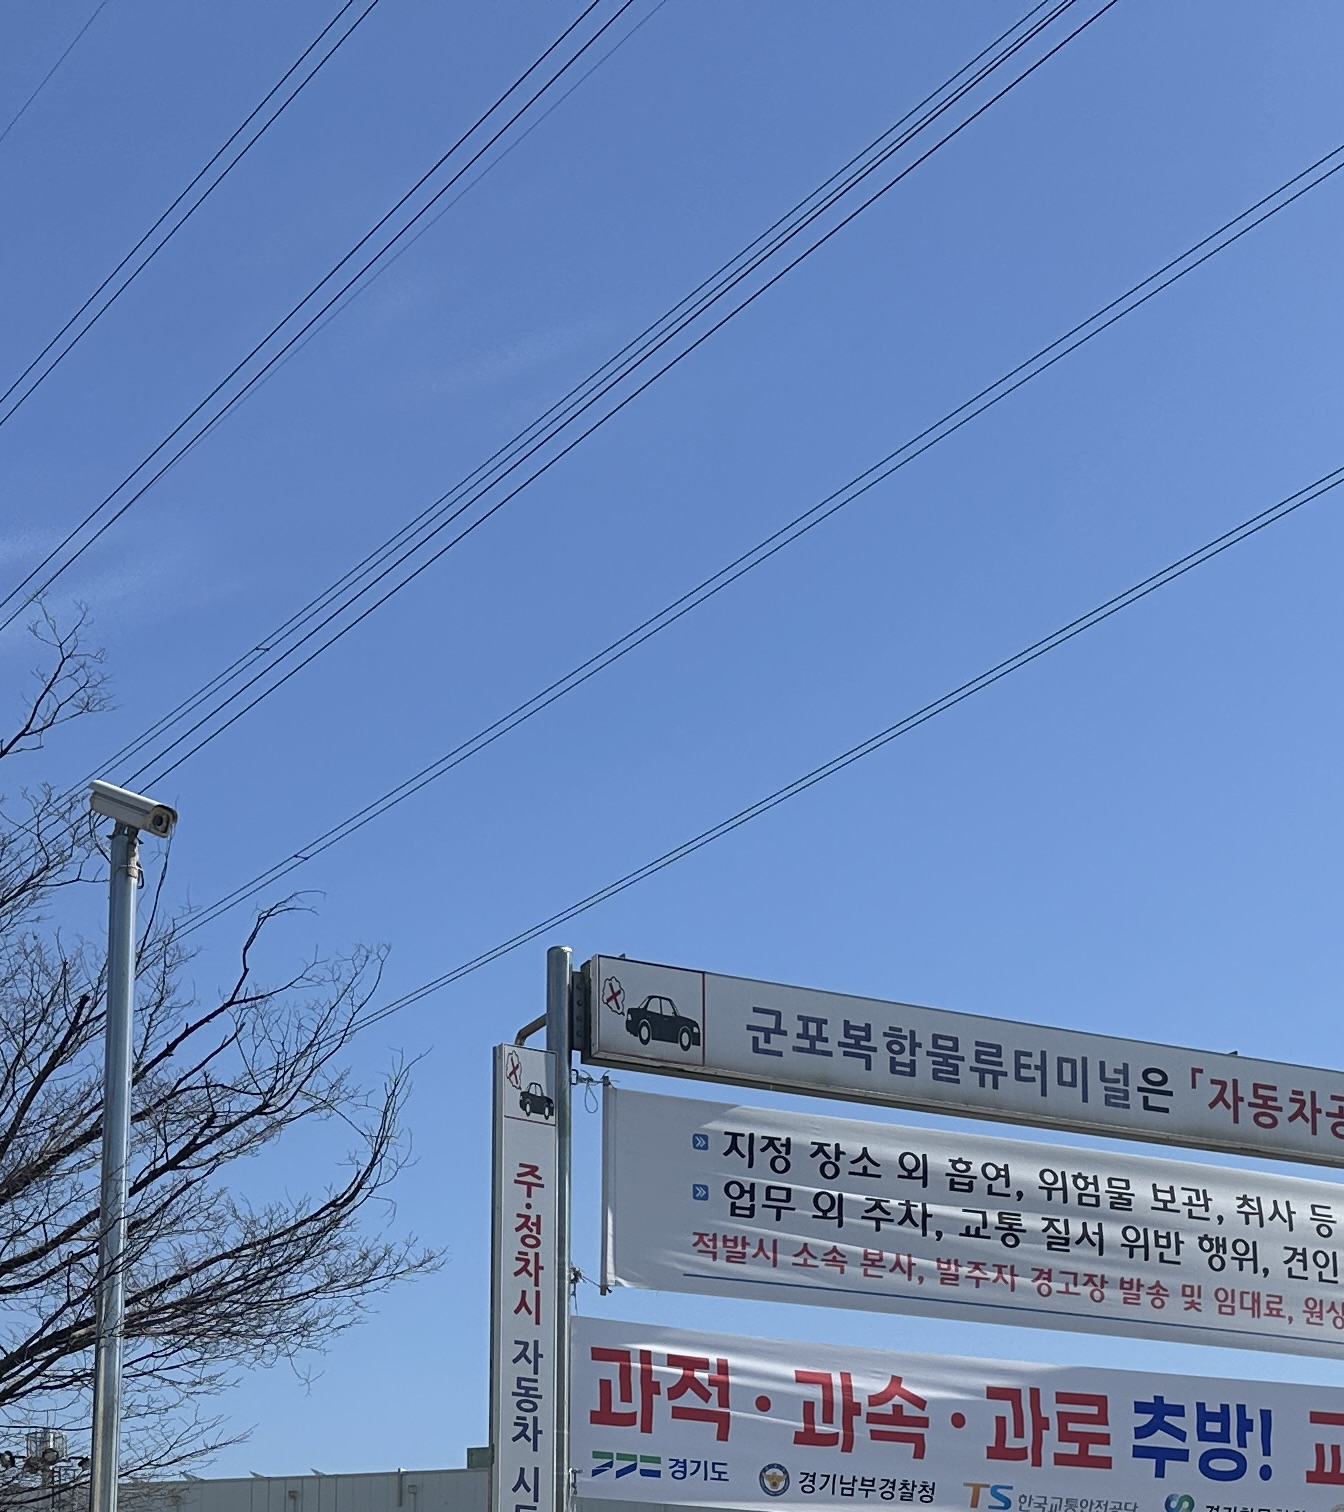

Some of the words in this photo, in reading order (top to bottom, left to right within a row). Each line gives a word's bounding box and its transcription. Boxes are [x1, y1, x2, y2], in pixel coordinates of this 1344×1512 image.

[723, 1131, 792, 1174] 지정
[808, 1141, 882, 1181] 장소
[896, 1151, 927, 1188] 외
[944, 1157, 1023, 1201] 흡연,
[1037, 1167, 1135, 1212] 위험물
[1150, 1182, 1224, 1225] 보관,
[1235, 1194, 1296, 1232] 취사
[1309, 1203, 1337, 1239] 등
[723, 1179, 795, 1223] 업무
[810, 1191, 844, 1229] 외
[860, 1198, 944, 1242] 주차,
[957, 1207, 1028, 1249] 교통
[1040, 1214, 1105, 1255] 질서
[1120, 1224, 1185, 1266] 위반
[1197, 1233, 1270, 1278] 행위,
[1282, 1244, 1339, 1284] 견인
[690, 1231, 780, 1269] 적발시
[790, 1242, 846, 1275] 소속
[861, 1247, 925, 1284] 본사,
[935, 1255, 1019, 1294] 발주자
[1030, 1266, 1109, 1304] 경고장
[1118, 1276, 1171, 1310] 발송
[1180, 1283, 1203, 1313] 및
[1214, 1286, 1294, 1325] 임대료,
[511, 1339, 544, 1453] 자동차
[1131, 1395, 1273, 1483] 추방!
[667, 1458, 730, 1482] 경기도
[797, 1471, 937, 1504] 경기남부경찰청
[963, 1482, 1013, 1511] TS
